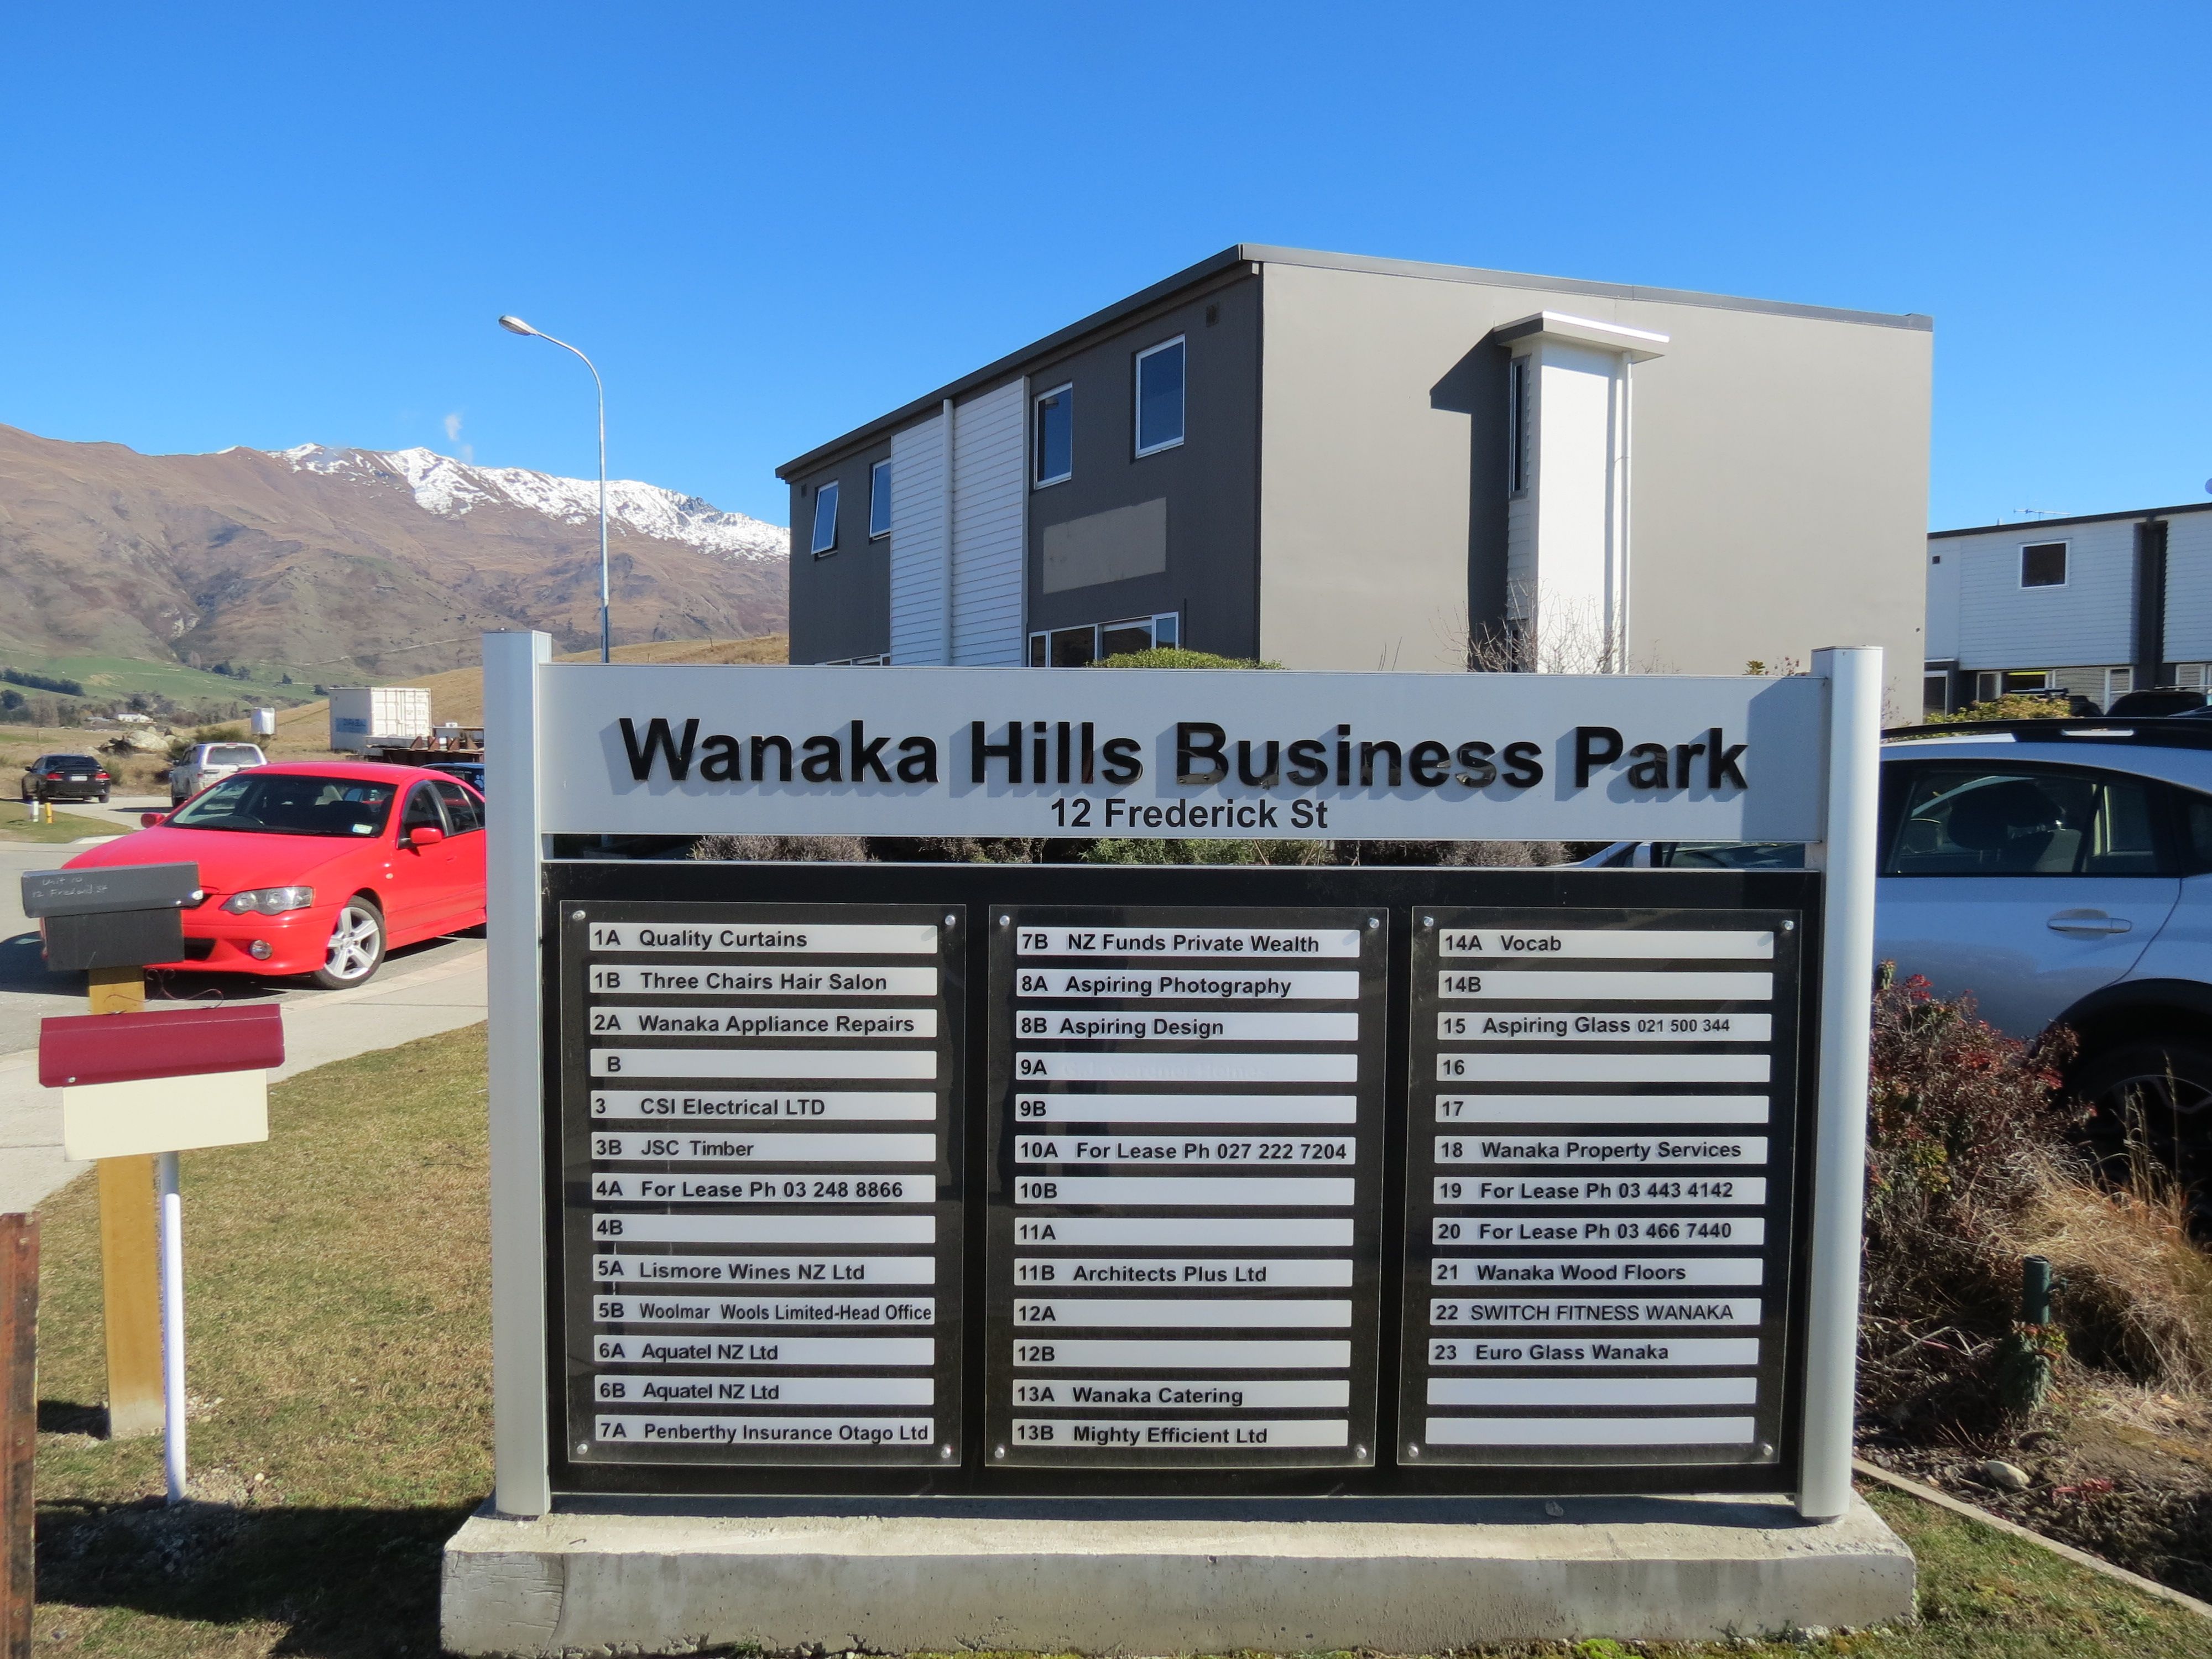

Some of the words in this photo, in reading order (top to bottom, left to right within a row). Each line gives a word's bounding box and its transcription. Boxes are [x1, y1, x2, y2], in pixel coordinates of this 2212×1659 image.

[619, 718, 939, 784] Wanaka
[971, 721, 1144, 787] Hills
[1176, 722, 1543, 790] Business
[1573, 726, 1749, 791] Park
[1051, 798, 1091, 827] 12
[1105, 798, 1278, 828] Frederick
[1291, 799, 1328, 828] St
[593, 930, 622, 947] 1A
[639, 929, 713, 951] Quality
[720, 930, 807, 947] Curtains
[1022, 933, 1048, 950] 7B
[1068, 933, 1096, 950] NZ
[1103, 933, 1166, 951] Funds
[1173, 935, 1244, 952] Private
[1250, 935, 1319, 952] Wealth
[1446, 935, 1483, 951] 14A
[1500, 935, 1562, 951] Vocab
[595, 972, 620, 988] 1B
[640, 972, 699, 989] Three
[706, 972, 773, 989] Chairs
[781, 973, 822, 990] Hair
[829, 973, 886, 990] Salon
[1021, 975, 1049, 992] 8A
[1063, 975, 1152, 998] Aspiring
[1160, 977, 1291, 998] Photography
[1444, 976, 1481, 993] 14B
[593, 1015, 622, 1031] 2A
[639, 1015, 719, 1032] Wanaka
[726, 1015, 828, 1036] Appliance
[837, 1015, 914, 1036] Repairs
[1021, 1017, 1047, 1034] 8B
[1059, 1018, 1146, 1038] Aspiring
[1154, 1018, 1223, 1038] Design
[1444, 1018, 1465, 1034] 15
[1483, 1016, 1567, 1037] Aspiring
[1574, 1016, 1630, 1033] Glass
[1637, 1019, 1663, 1032] 021
[1671, 1019, 1697, 1032] 500
[1703, 1019, 1730, 1032] 344
[607, 1056, 621, 1072] B
[1021, 1059, 1047, 1075] 9A
[1443, 1059, 1465, 1076] 16
[596, 1098, 606, 1114] 3
[640, 1098, 675, 1115] CSI
[683, 1098, 778, 1115] Electrical
[786, 1099, 825, 1115] LTD
[1020, 1100, 1046, 1117] 9B
[1442, 1100, 1464, 1117] 17
[596, 1139, 622, 1155] 3B
[641, 1139, 679, 1156] JSC
[689, 1140, 754, 1156] Timber
[1021, 1142, 1058, 1158] 10A
[1077, 1142, 1111, 1159] For
[1118, 1142, 1177, 1159] Lease
[1185, 1143, 1209, 1159] Ph
[1217, 1143, 1251, 1159] 027
[1259, 1143, 1293, 1159] 222
[1301, 1144, 1347, 1160] 7204
[1441, 1142, 1463, 1158] 18
[1481, 1142, 1559, 1158] Wanaka
[1567, 1142, 1651, 1162] Property
[1657, 1141, 1741, 1158] Services
[596, 1180, 623, 1196] 4A
[641, 1181, 676, 1197] For
[682, 1181, 743, 1198] Lease
[750, 1181, 776, 1197] Ph
[784, 1181, 806, 1198] 03
[813, 1181, 848, 1198] 248
[855, 1181, 902, 1198] 8866
[1020, 1182, 1057, 1199] 10B
[1440, 1182, 1462, 1198] 19
[1481, 1182, 1515, 1199] For
[1521, 1183, 1579, 1199] Lease
[1586, 1182, 1611, 1198] Ph
[1619, 1182, 1641, 1198] 03
[1647, 1182, 1681, 1198] 443
[1687, 1182, 1733, 1198] 4142
[597, 1219, 623, 1235] 4B
[1020, 1224, 1056, 1240] 11A
[1438, 1223, 1460, 1239] 20
[1480, 1223, 1514, 1239] For
[1520, 1224, 1578, 1240] Lease
[1584, 1223, 1610, 1239] Ph
[1617, 1223, 1639, 1239] 03
[1645, 1223, 1680, 1239] 466
[1687, 1223, 1731, 1238] 7440
[598, 1260, 624, 1276] 5A
[640, 1262, 722, 1279] Lismore
[728, 1264, 791, 1280] Wines
[799, 1264, 826, 1280] NZ
[833, 1264, 864, 1280] Ltd
[1019, 1265, 1055, 1281] 11B
[1073, 1265, 1177, 1282] Architects
[1184, 1266, 1228, 1282] Plus
[1235, 1266, 1266, 1282] Ltd
[1437, 1264, 1457, 1280] 21
[1477, 1264, 1554, 1281] Wanaka
[1561, 1264, 1618, 1280] Wood
[1624, 1264, 1686, 1280] Floors
[599, 1302, 624, 1318] 5B
[639, 1303, 711, 1319] Woolmar
[721, 1304, 770, 1320] Wools
[775, 1305, 880, 1321] Limited-Head
[885, 1304, 931, 1320] Office
[1019, 1305, 1056, 1321] 12A
[1436, 1305, 1458, 1320] 22
[1470, 1305, 1550, 1321] SWITCH
[1557, 1305, 1640, 1321] FITNESS
[1646, 1305, 1734, 1321] WANAKA
[599, 1343, 625, 1358] 6A
[641, 1343, 711, 1363] Aquatel
[718, 1344, 744, 1360] NZ
[750, 1344, 778, 1360] Ltd
[1018, 1345, 1055, 1361] 12B
[1434, 1344, 1457, 1360] 23
[1476, 1344, 1522, 1360] Euro
[1529, 1344, 1585, 1360] Glass
[1592, 1344, 1668, 1360] Wanaka
[599, 1383, 626, 1398] 6B
[643, 1382, 713, 1402] Aquatel
[719, 1384, 745, 1399] NZ
[751, 1384, 779, 1400] Ltd
[1018, 1386, 1055, 1402] 13A
[1072, 1386, 1151, 1403] Wanaka
[1159, 1387, 1243, 1405] Catering
[601, 1422, 627, 1438] 7A
[645, 1423, 737, 1442] Penberthy
[743, 1425, 833, 1441] Insurance
[839, 1425, 893, 1443] Otago
[900, 1425, 928, 1440] Ltd
[1017, 1425, 1054, 1441] 13B
[1074, 1426, 1141, 1444] Mighty
[1147, 1427, 1229, 1443] Efficient
[1237, 1428, 1267, 1443] Ltd
